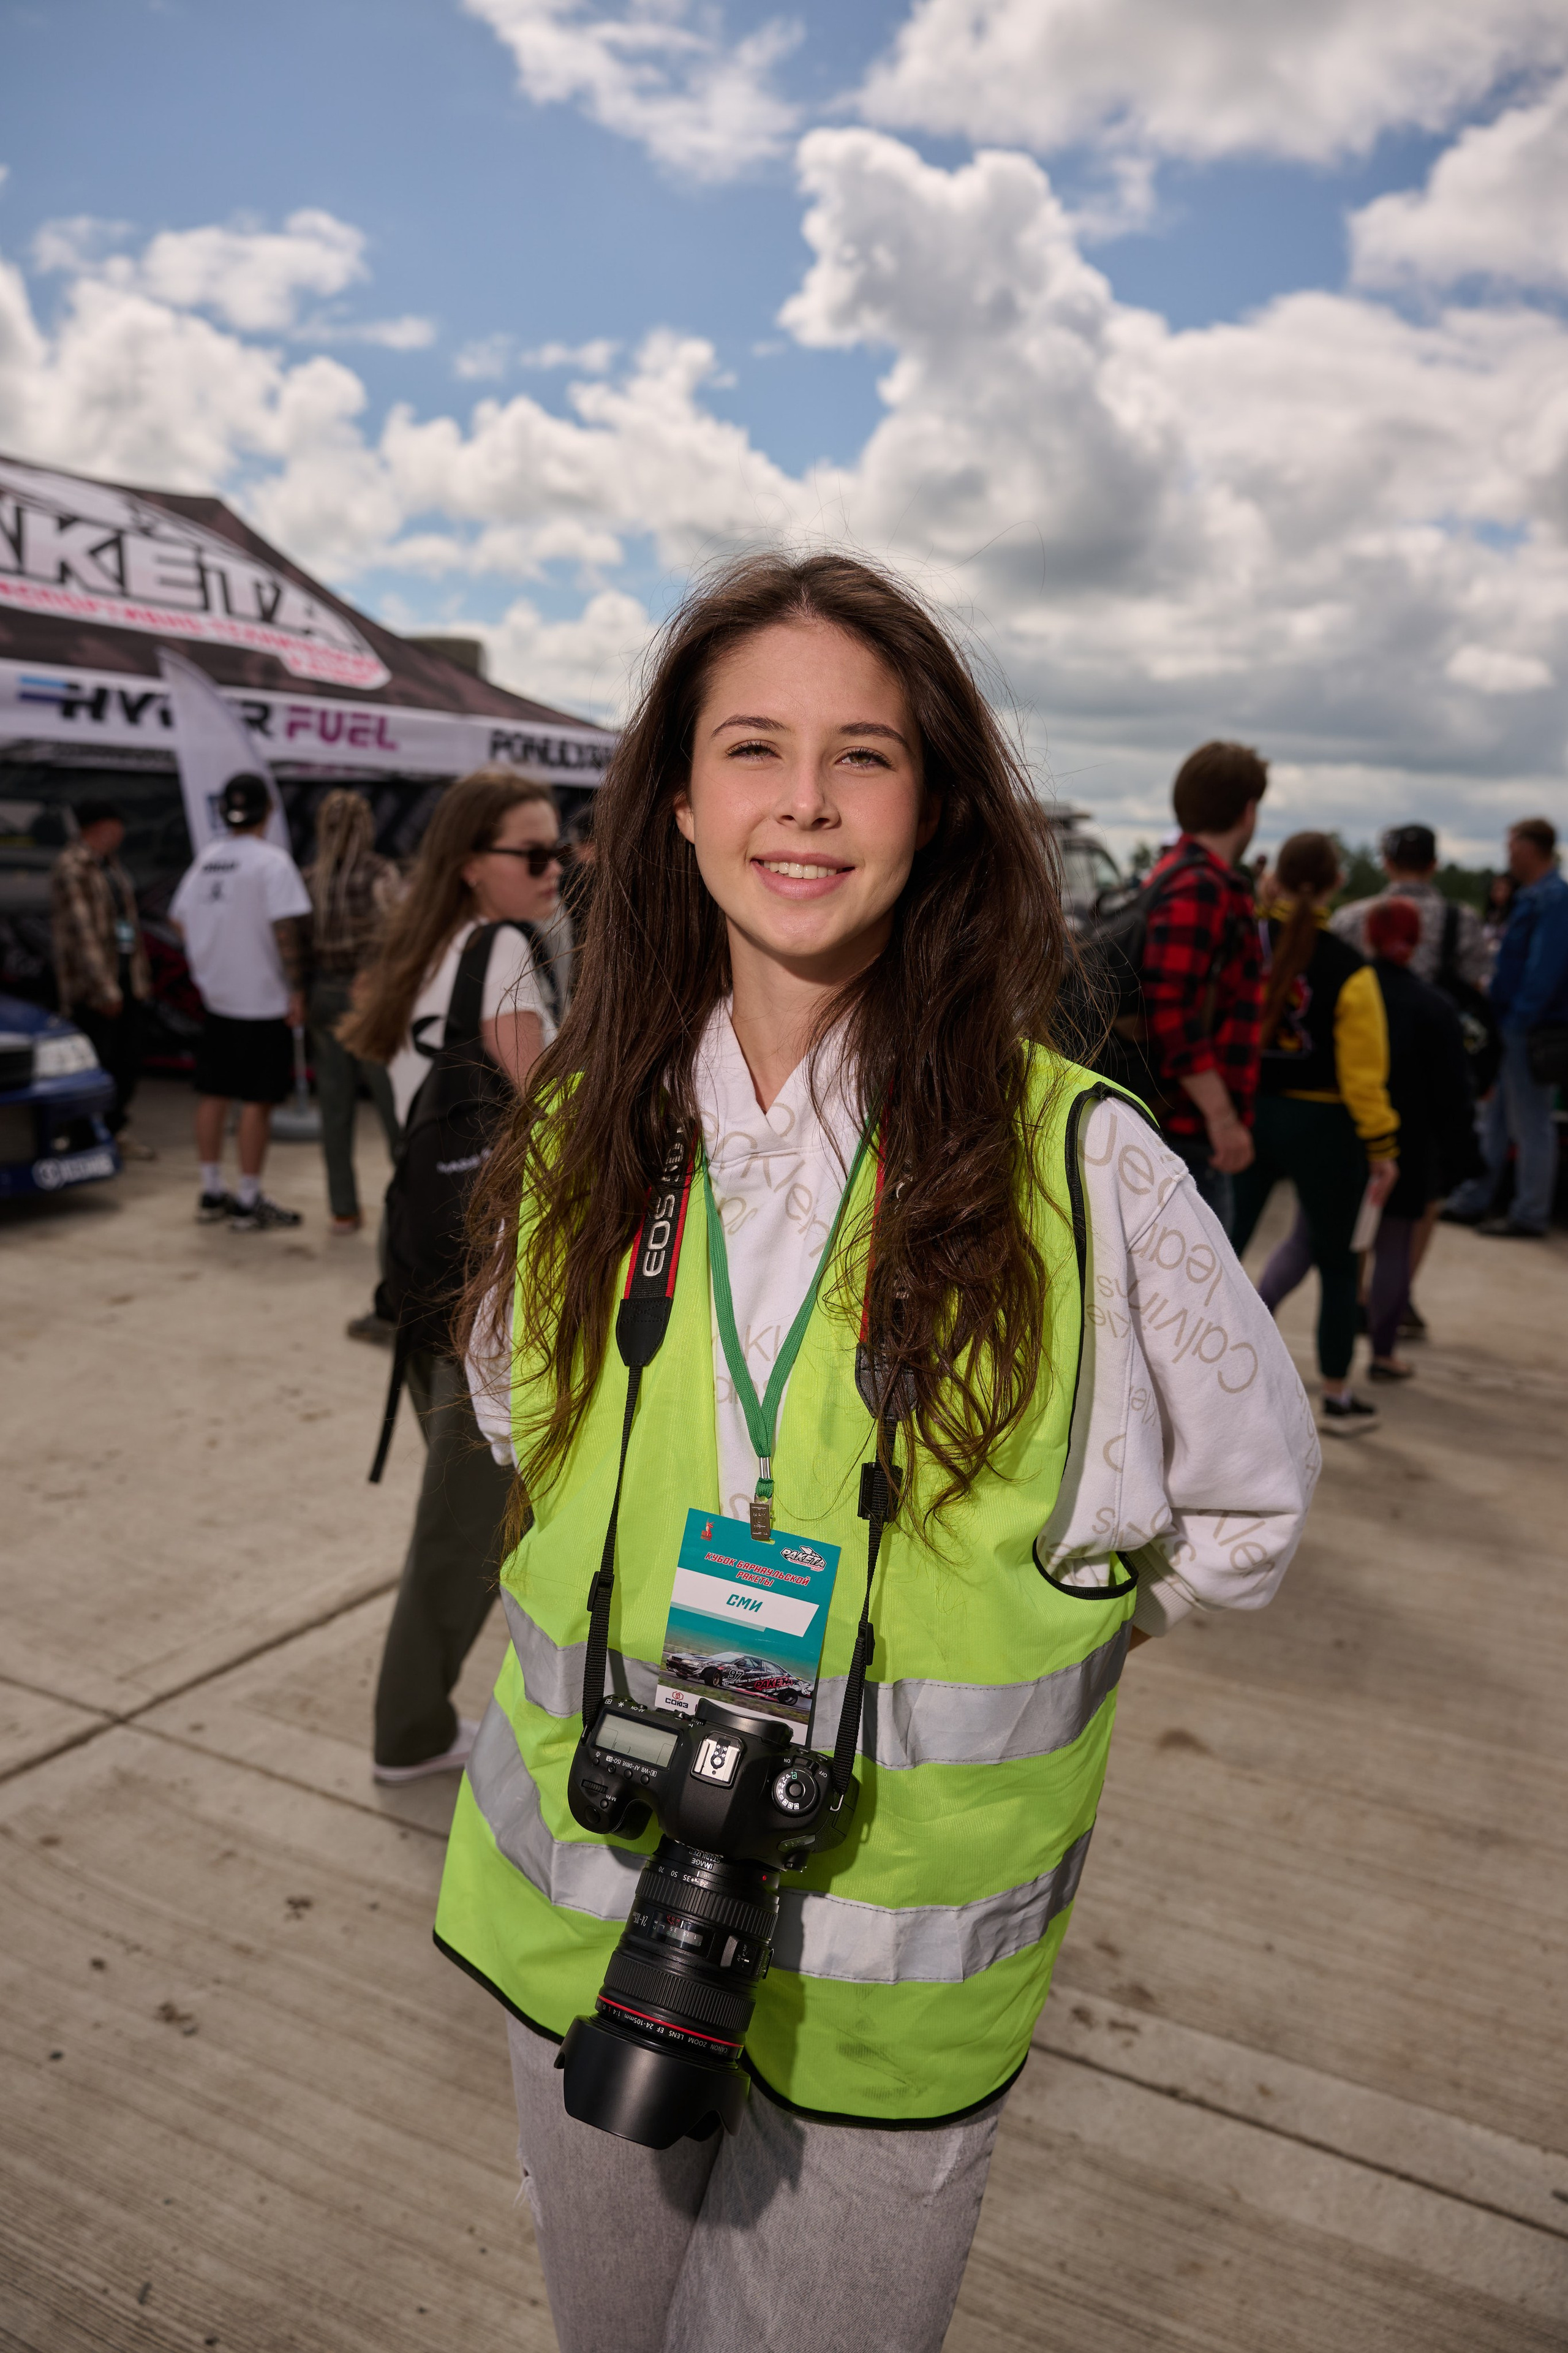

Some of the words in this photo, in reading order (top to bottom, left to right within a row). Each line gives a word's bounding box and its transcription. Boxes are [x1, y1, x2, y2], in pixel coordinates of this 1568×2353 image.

[285, 704, 399, 751] FUEL
[643, 1194, 675, 1277] EOS
[781, 1548, 826, 1568] РАКЕТА
[705, 1552, 736, 1566] КУБОК
[736, 1561, 810, 1587] БАРНАУЛЬСКОЙ
[736, 1571, 774, 1587] РАКЕТЫ
[726, 1594, 763, 1612] СМИ
[728, 1669, 744, 1680] 97
[665, 1698, 688, 1709] СОЮЗ
[692, 1857, 713, 1870] IMAGE
[624, 2013, 654, 2030] 24-105mm
[668, 2030, 684, 2041] LENS
[687, 2036, 707, 2048] ZOOM
[710, 2044, 728, 2053] CANON
